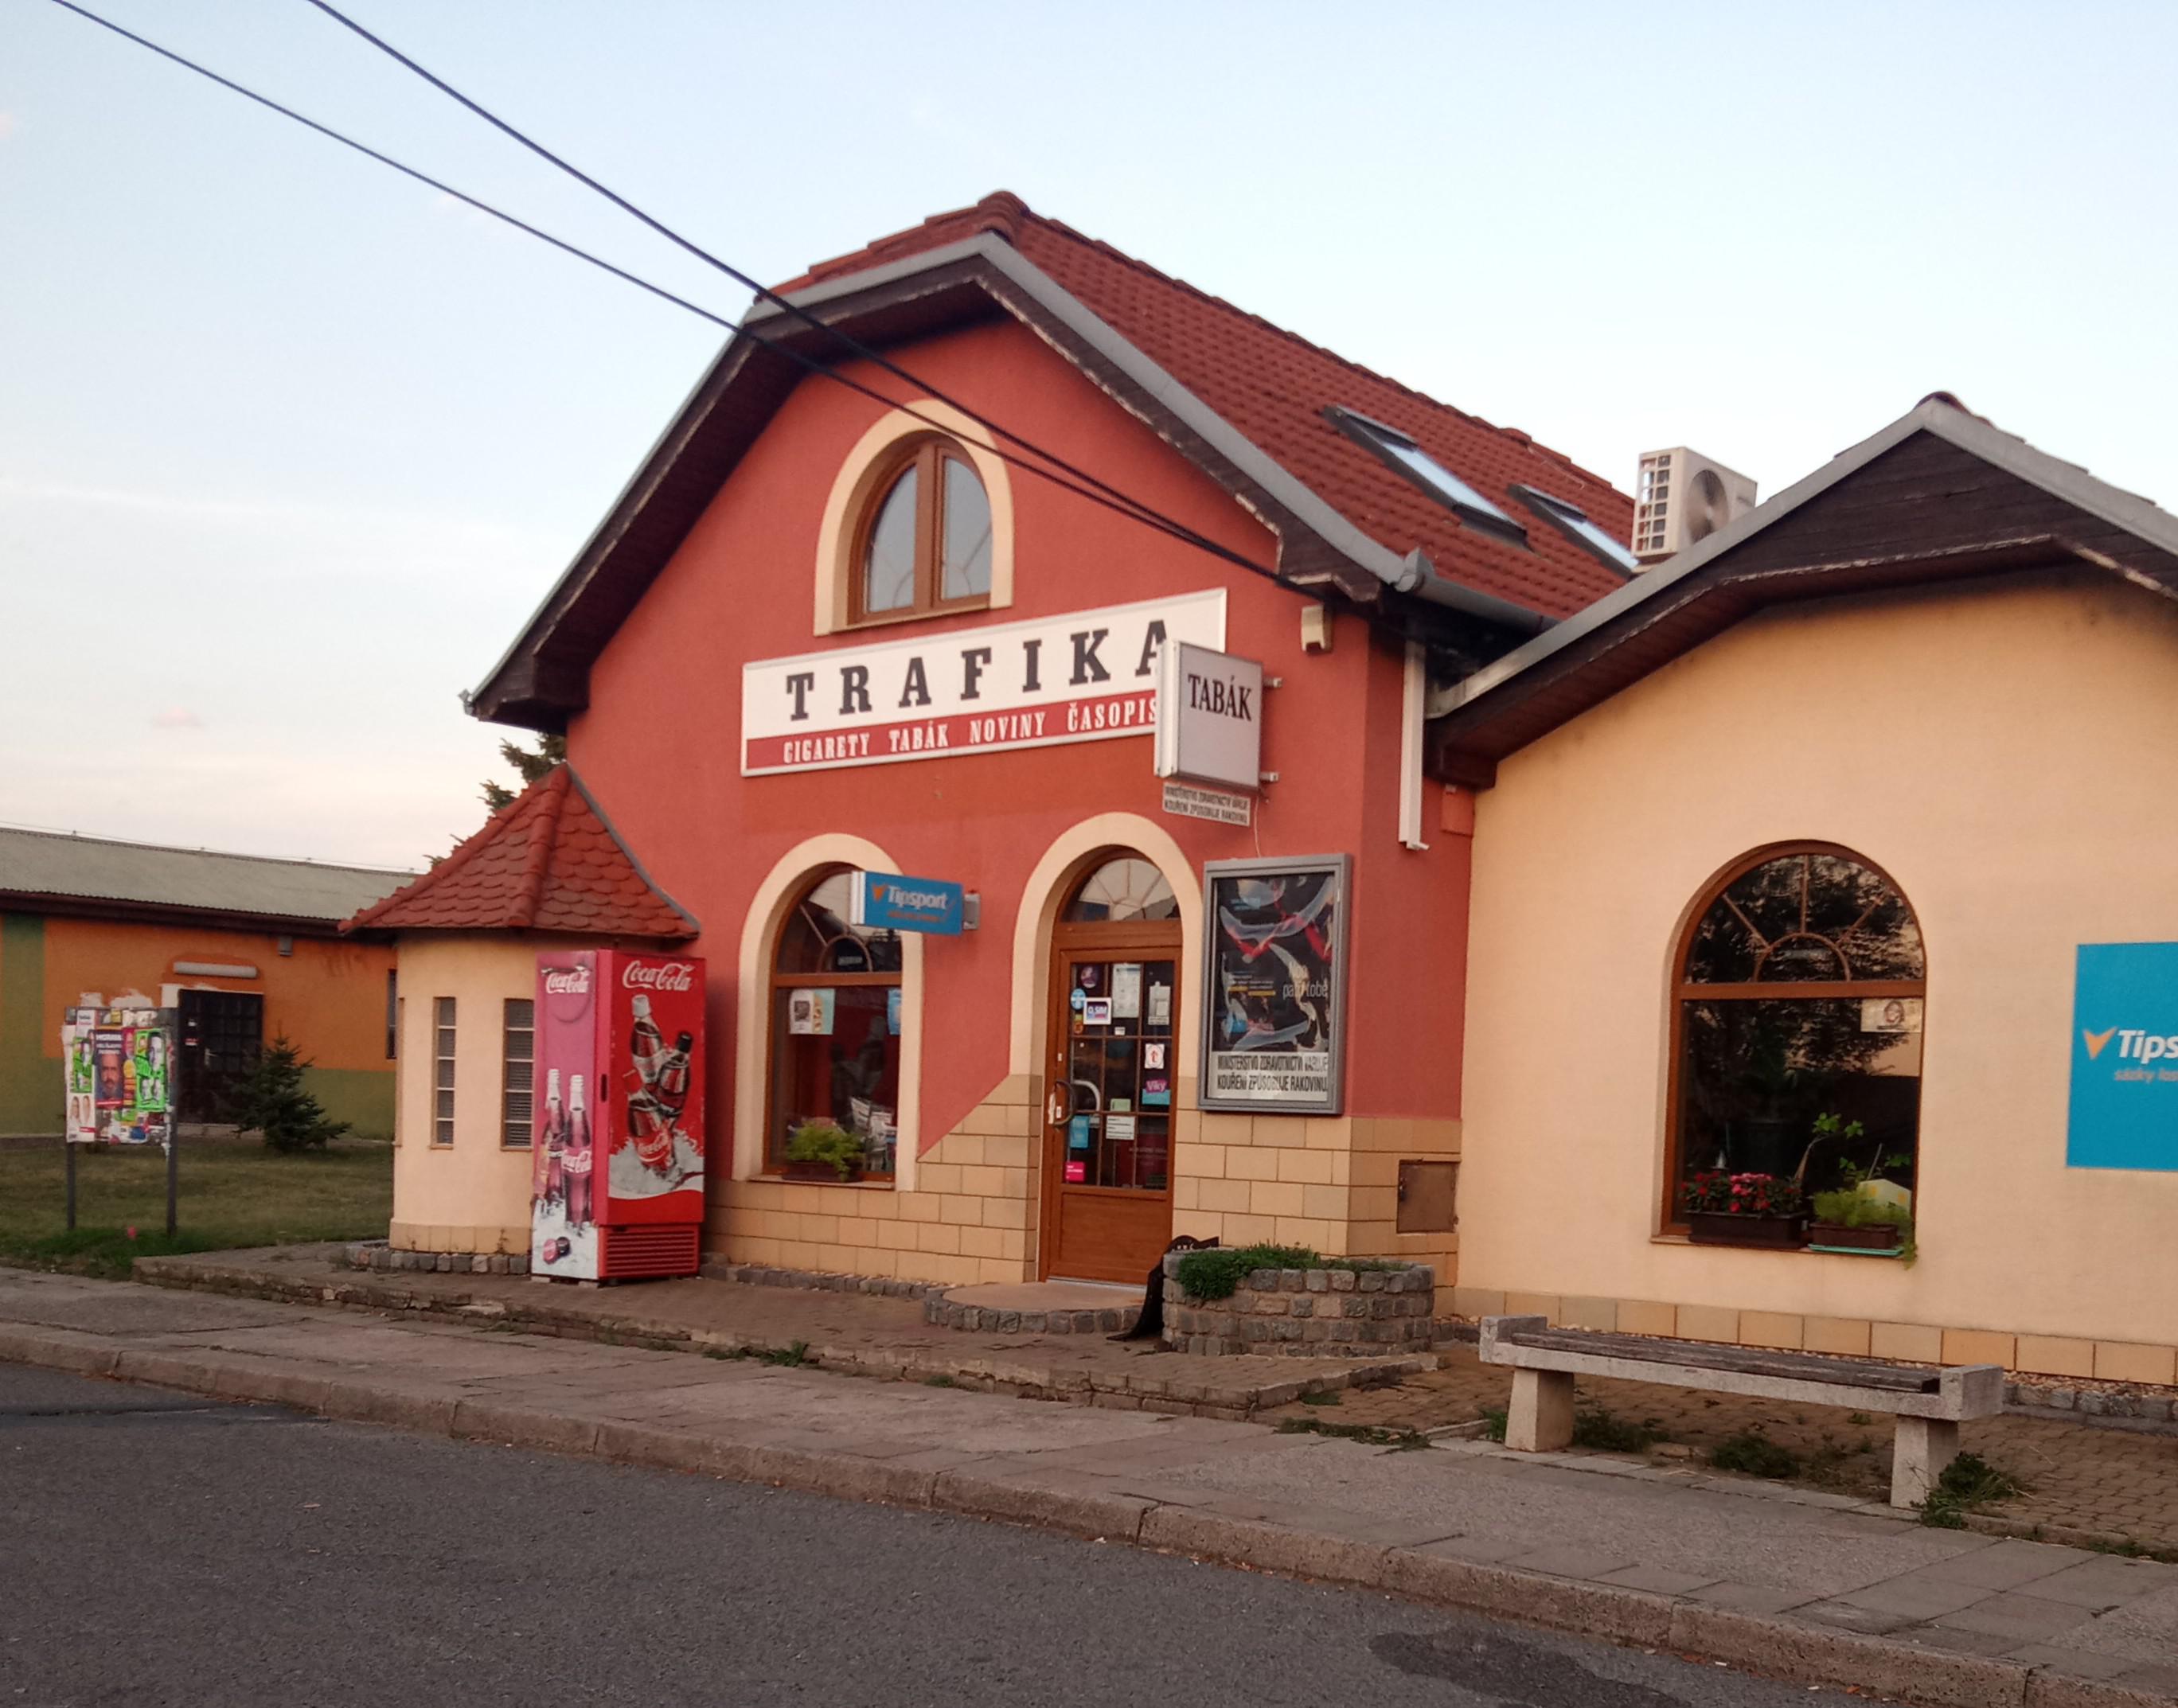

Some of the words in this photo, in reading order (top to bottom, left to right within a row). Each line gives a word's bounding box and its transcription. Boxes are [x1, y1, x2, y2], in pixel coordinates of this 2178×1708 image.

[786, 620, 1167, 721] TRAFIKA
[1188, 673, 1252, 722] TABÁK
[783, 732, 870, 764] CIGARETY
[889, 720, 949, 752] TABÁK
[970, 712, 1046, 744] NOVINY
[888, 884, 948, 910] Tipsport
